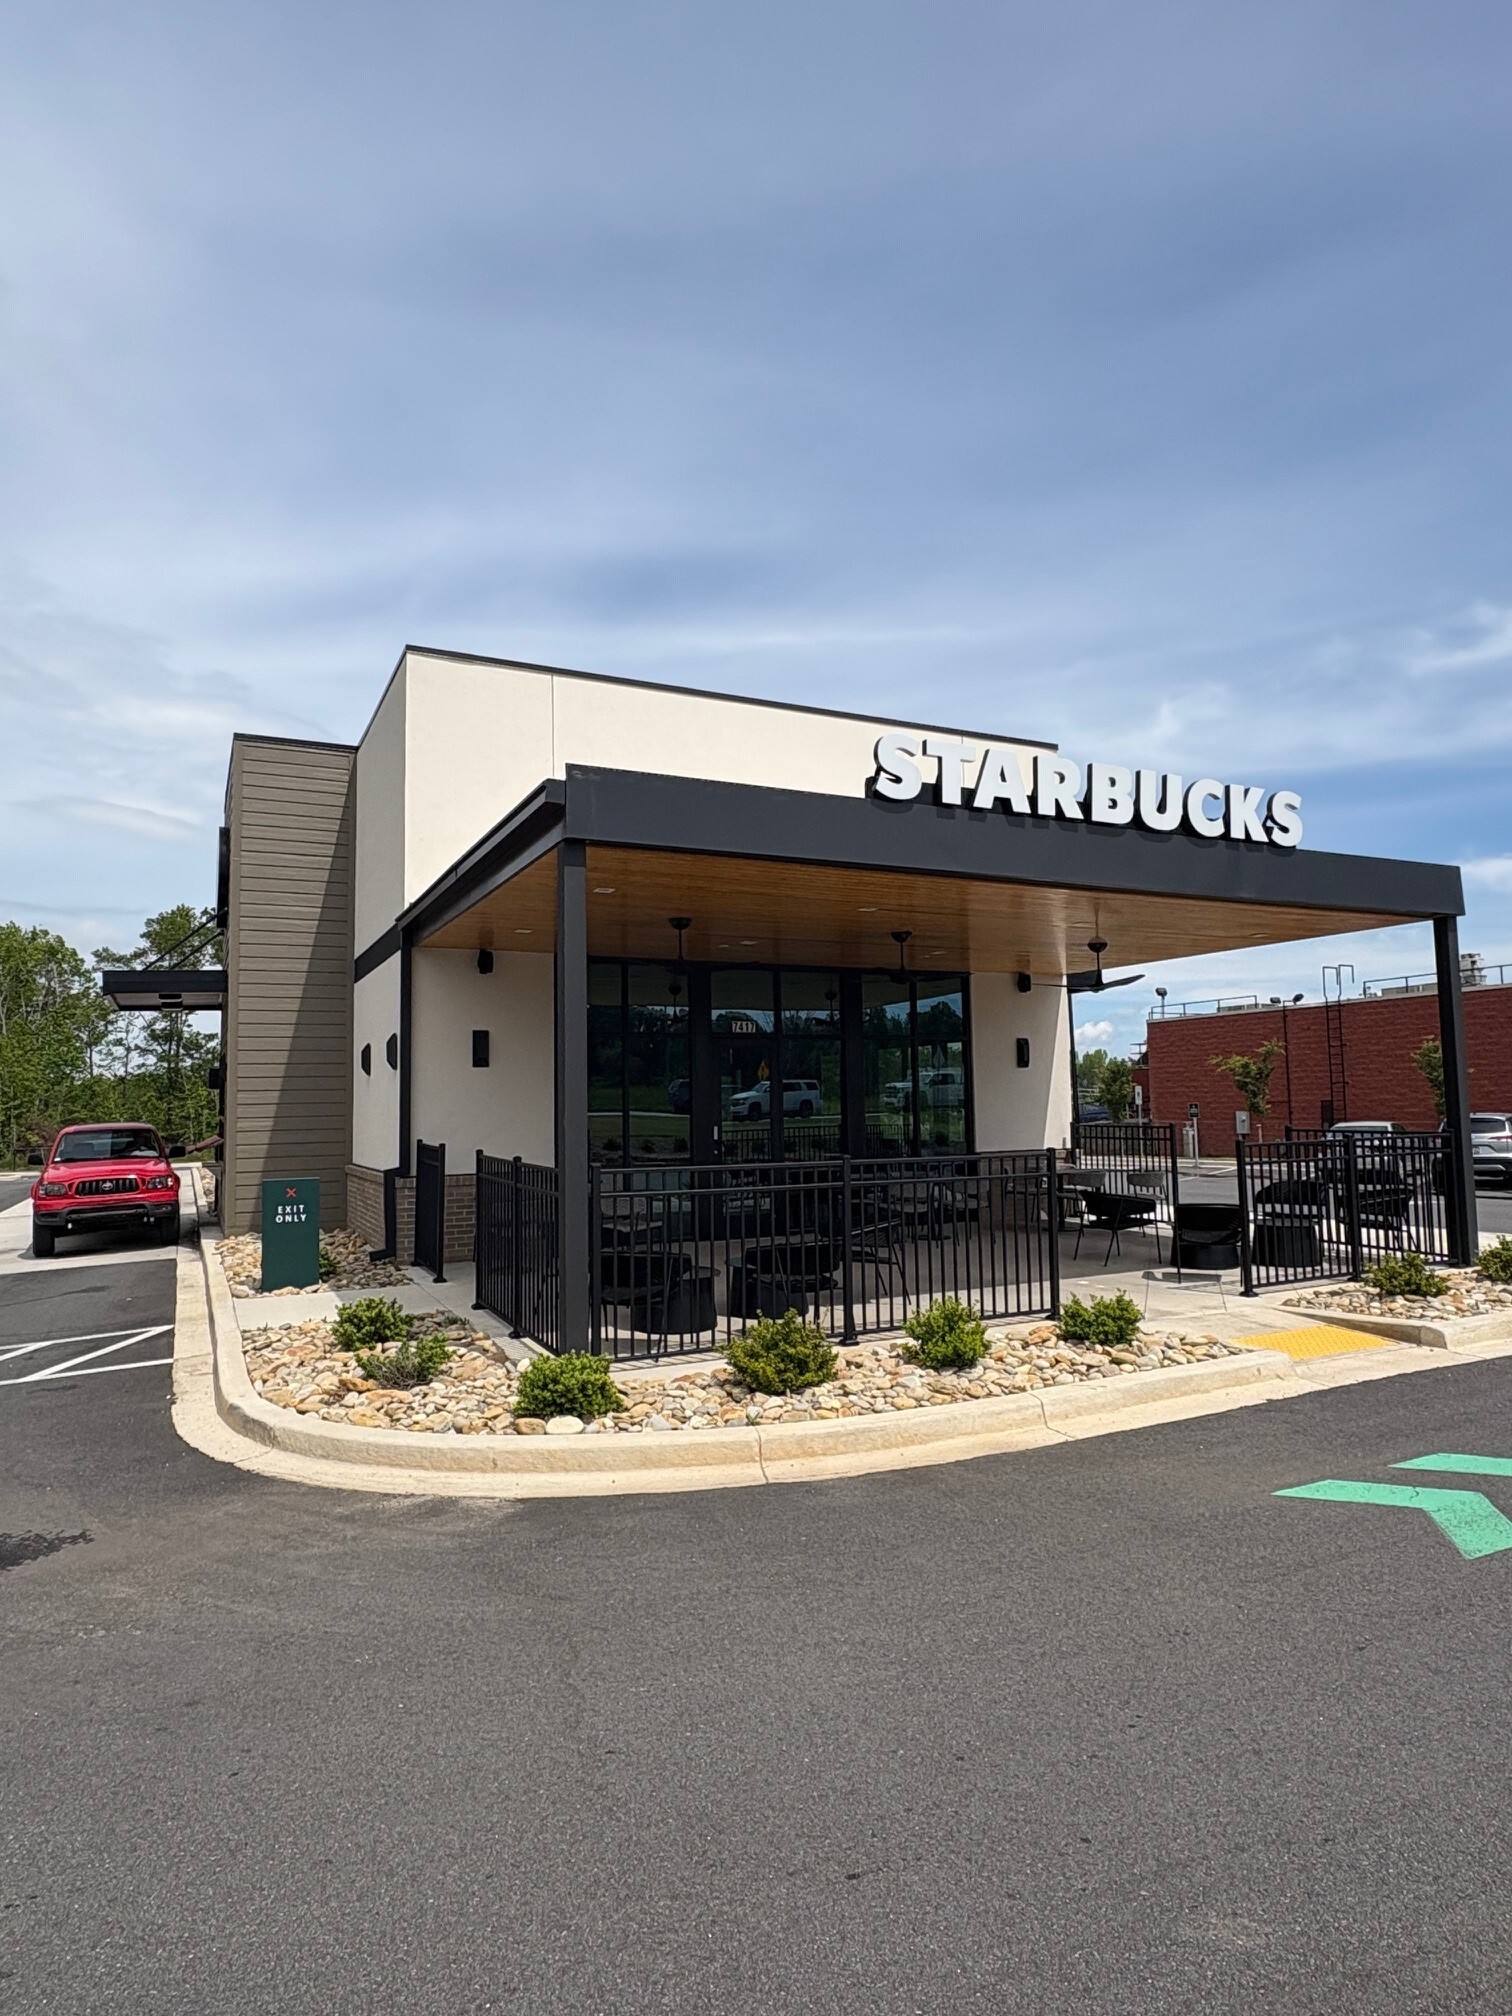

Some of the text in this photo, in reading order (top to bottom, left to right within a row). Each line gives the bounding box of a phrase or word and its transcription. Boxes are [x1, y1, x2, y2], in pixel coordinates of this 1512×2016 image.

[874, 734, 1304, 848] STARBUCKS
[278, 1205, 305, 1214] EXIT
[275, 1214, 307, 1223] ONLY
